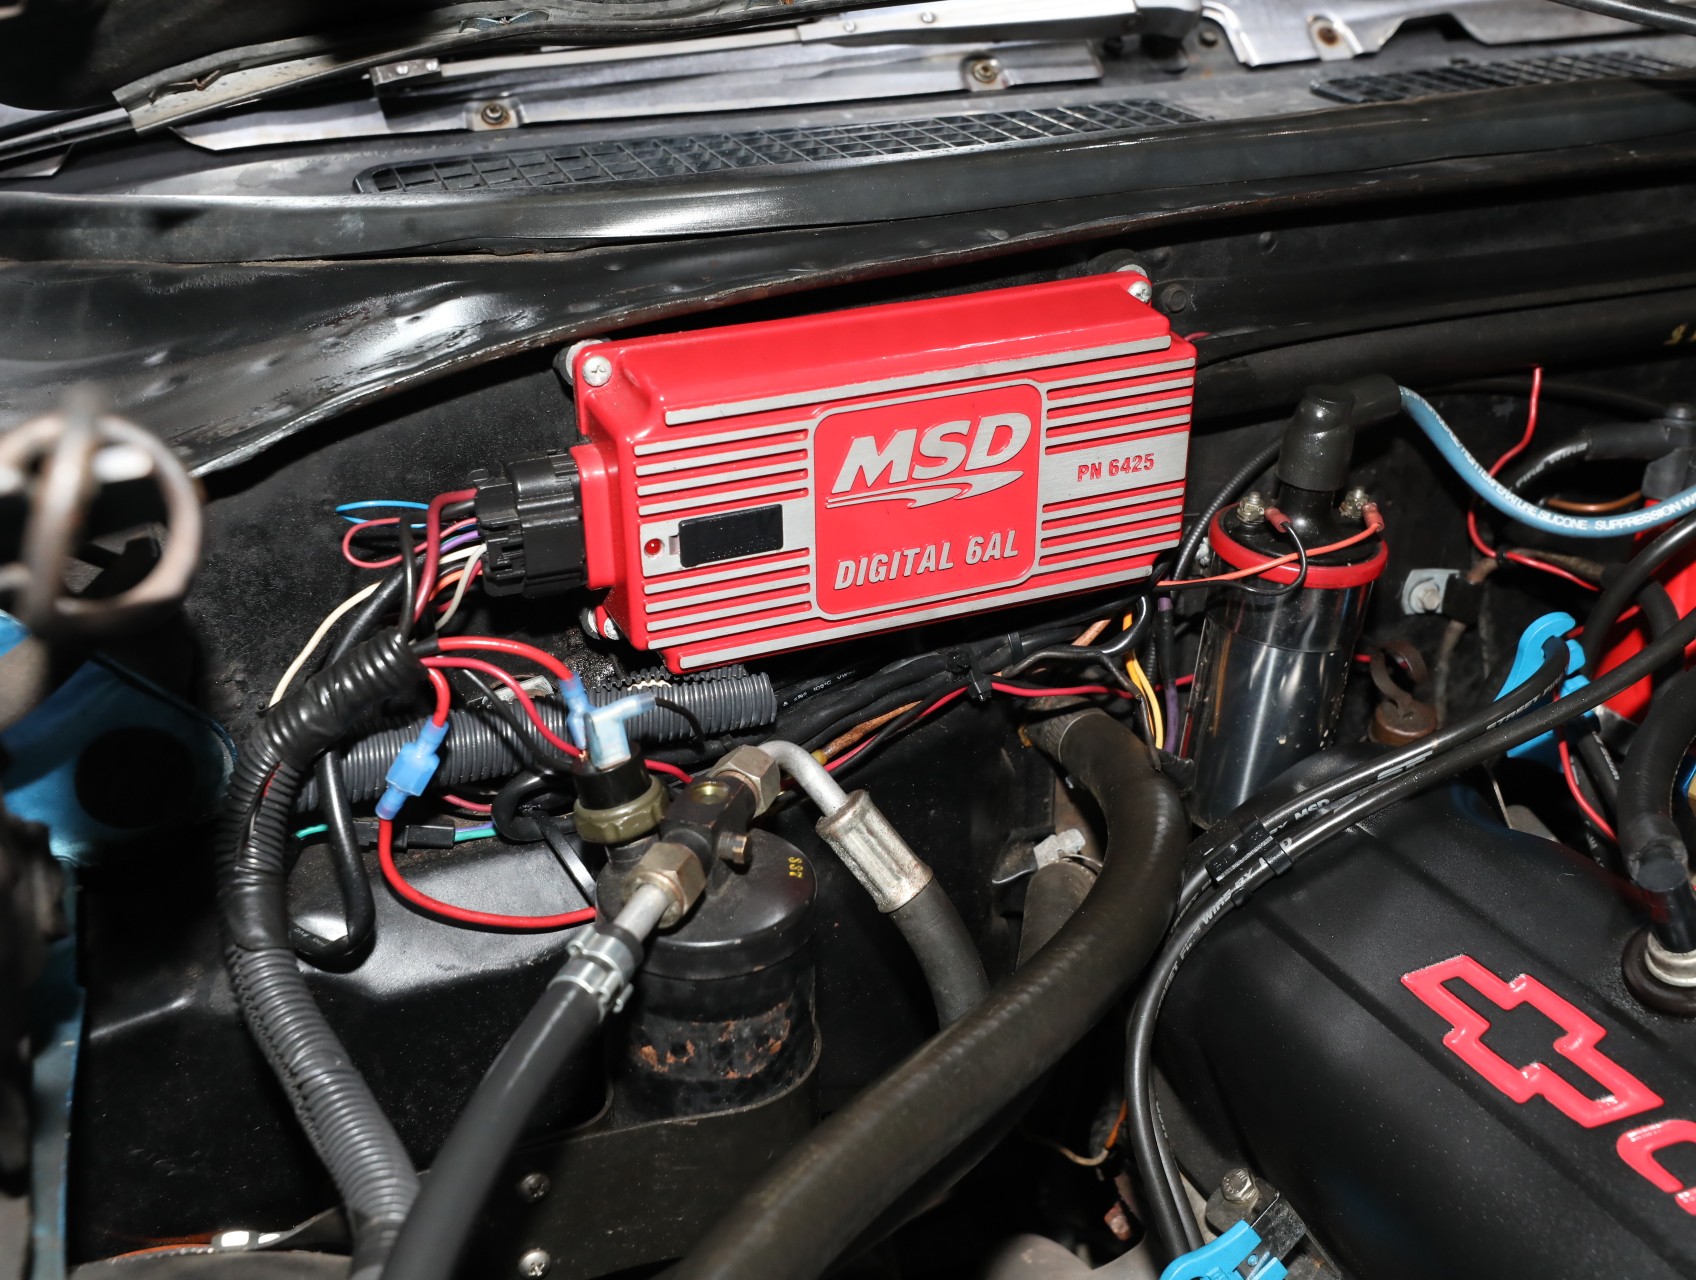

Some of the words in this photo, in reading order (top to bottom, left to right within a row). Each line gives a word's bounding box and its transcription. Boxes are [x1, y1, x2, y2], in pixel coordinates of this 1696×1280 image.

[831, 412, 1032, 494] MSD
[1078, 461, 1102, 482] PN
[1109, 453, 1155, 477] 6425
[1538, 508, 1588, 530] SILICONE
[1594, 501, 1681, 531] SUPPRESSION
[834, 541, 954, 590] DIGITAL
[965, 530, 1019, 565] 6AL
[1294, 798, 1331, 821] MSD
